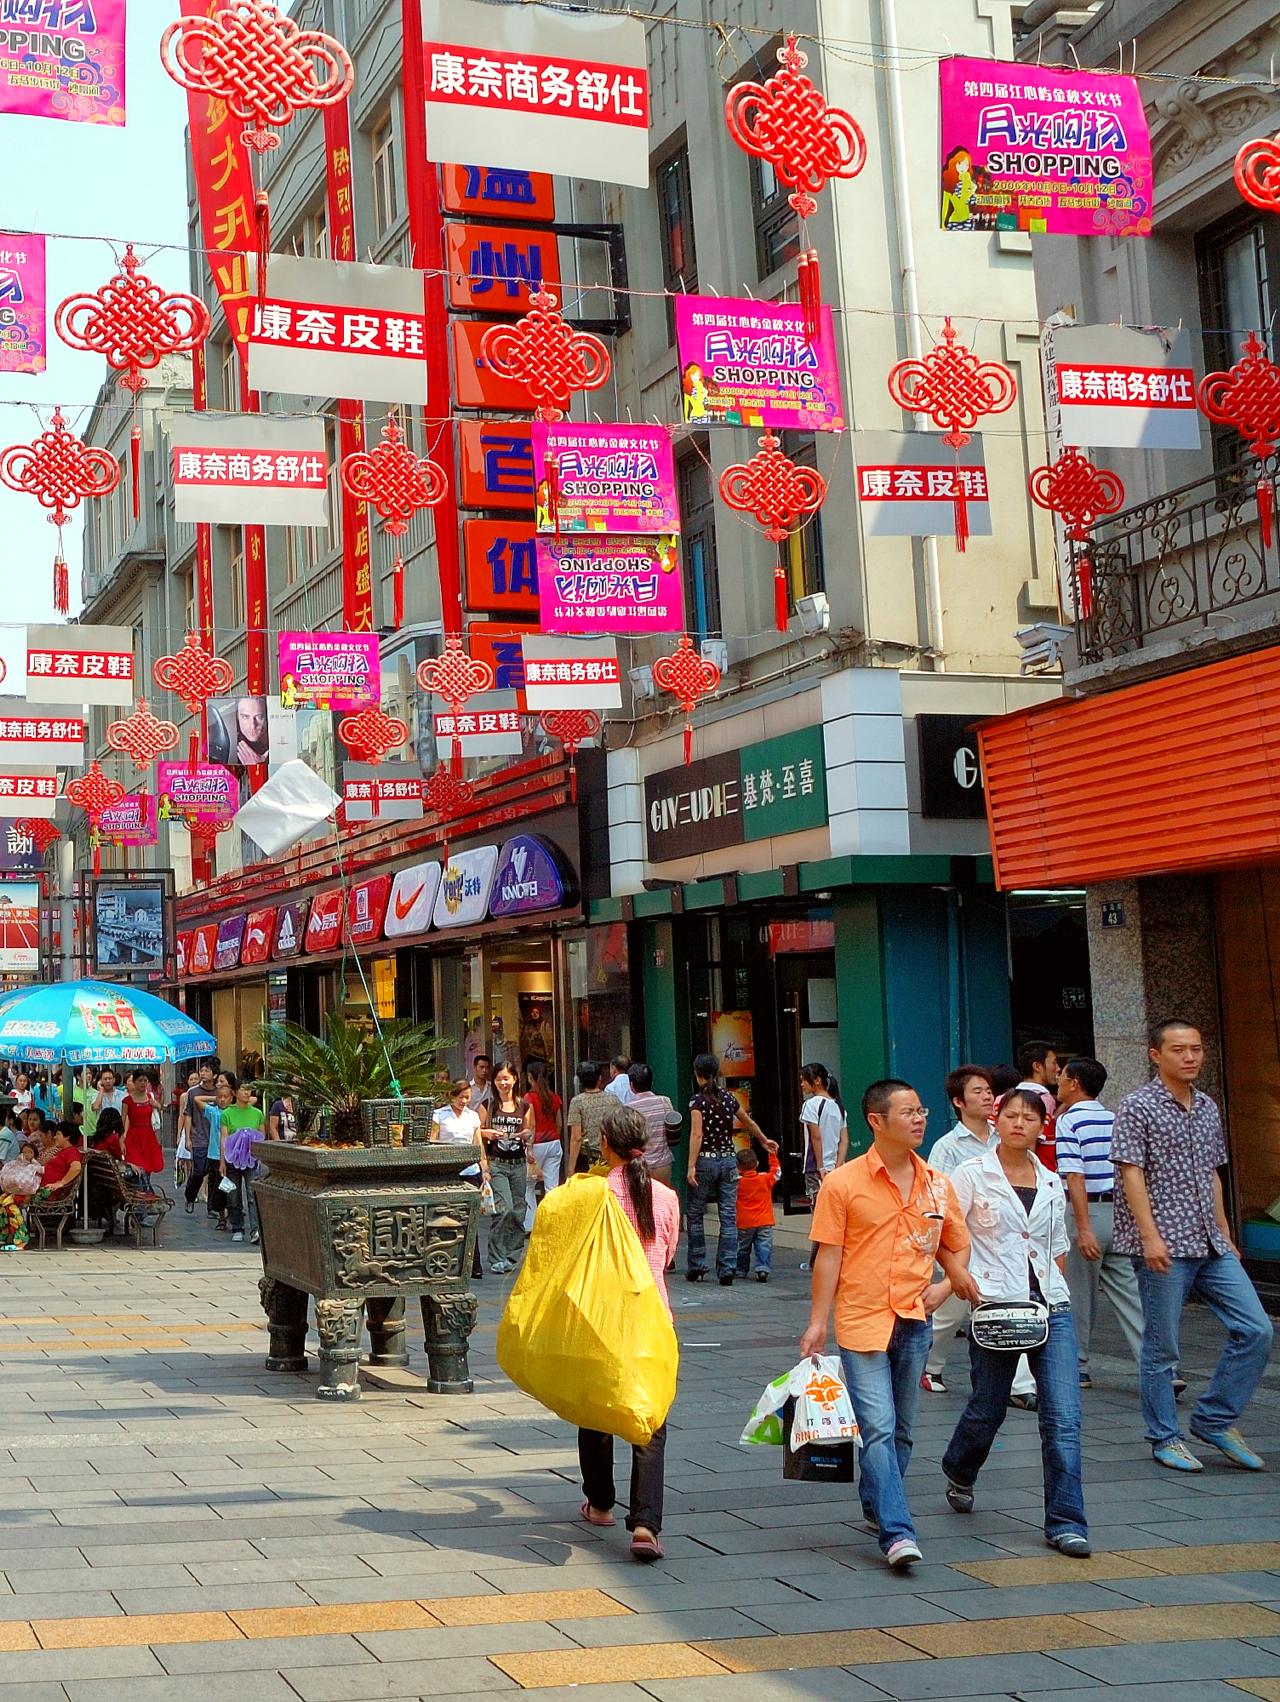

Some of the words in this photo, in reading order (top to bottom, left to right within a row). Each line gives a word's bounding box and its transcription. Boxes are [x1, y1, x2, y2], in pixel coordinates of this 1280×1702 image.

[429, 52, 644, 118] 康奈商务舒仕
[964, 80, 1122, 107] 第四届江心屿金秋文化节
[977, 103, 1127, 152] 月光购物
[988, 152, 1120, 177] SHOPPING
[251, 302, 424, 355] 康奈皮鞋
[692, 313, 814, 334] 第四届江心屿金秋文化
[705, 330, 818, 369] 月光购物
[714, 367, 814, 387] SHOPPING
[1061, 369, 1192, 402] 康奈商务舒仕
[178, 451, 323, 482] 康奈商务舒仕
[558, 450, 658, 480] 月光购物
[564, 482, 654, 496] SHOPPING
[861, 467, 987, 499] 康奈皮鞋
[560, 558, 651, 572] SHOPPING
[554, 574, 658, 603] 月光购物
[28, 653, 131, 677] 康奈皮鞋
[296, 652, 369, 673] 月光购物
[527, 662, 616, 681] 康奈商务舒仕
[300, 674, 365, 685] SHOPPING
[437, 713, 518, 733] 康奈皮鞋
[172, 776, 229, 793] 月光购物
[175, 793, 227, 802] SHOPPING
[1108, 912, 1119, 925] 43
